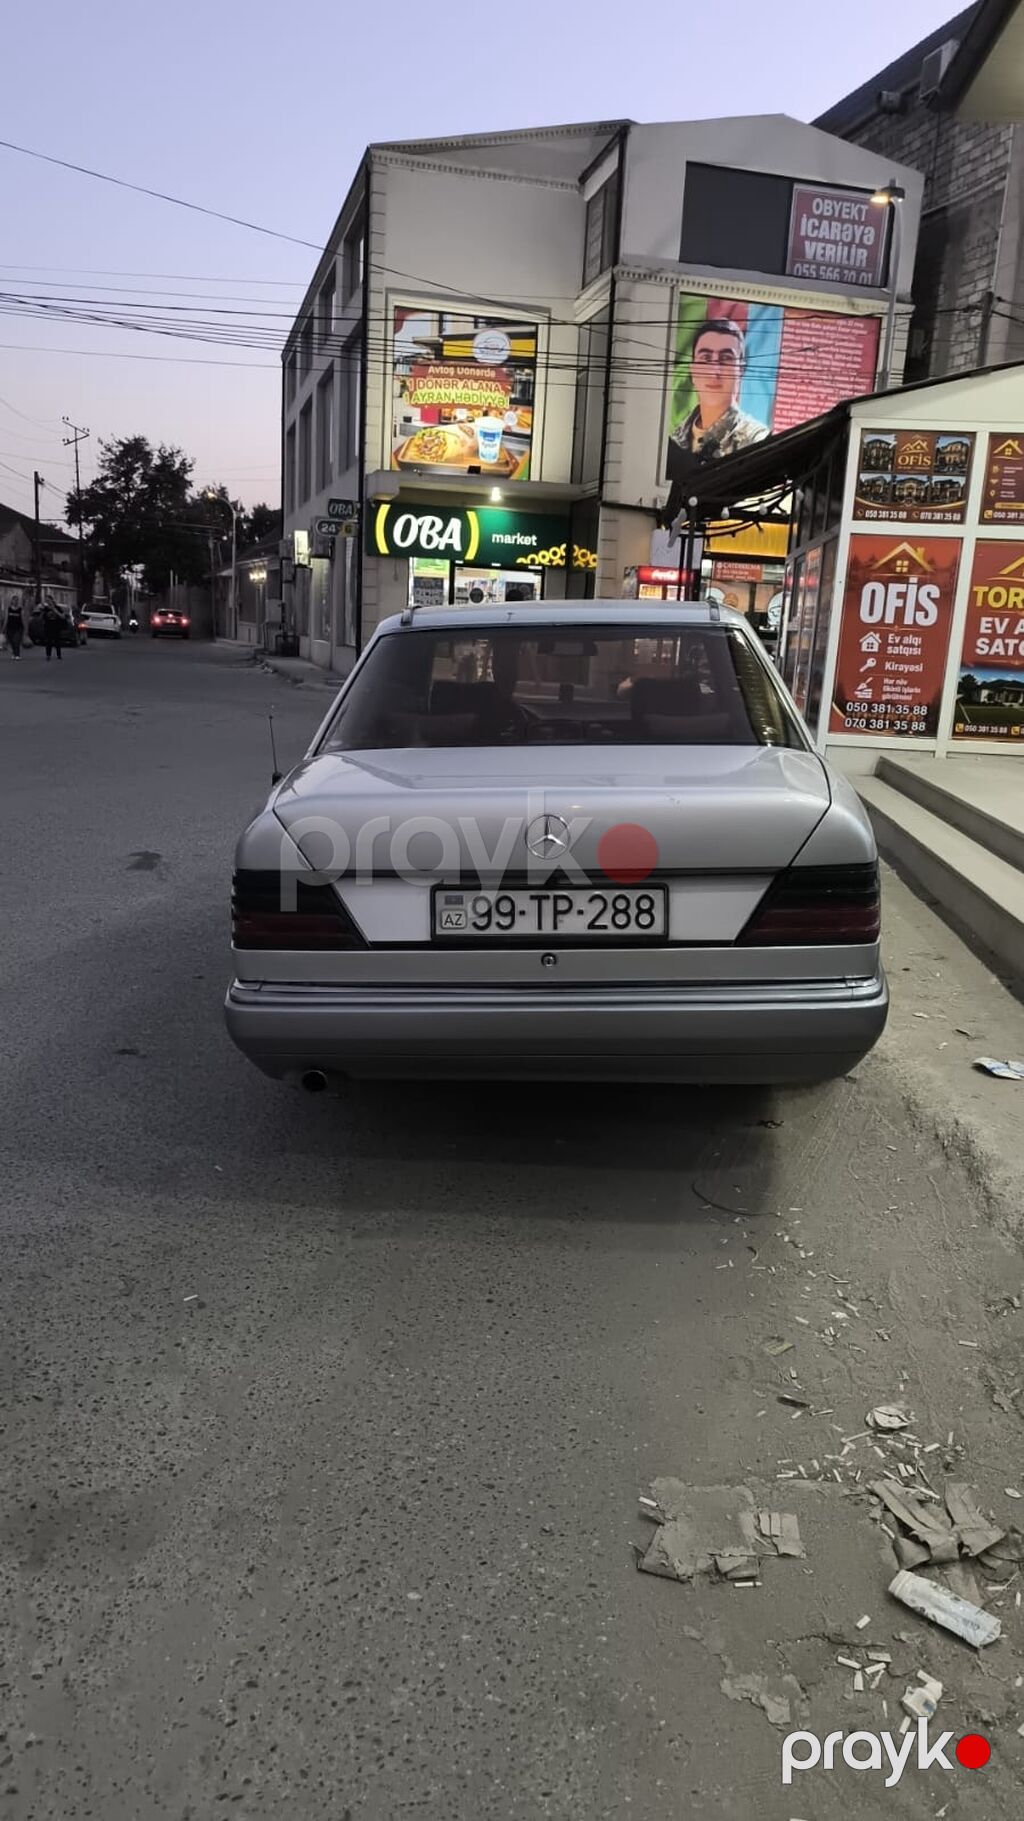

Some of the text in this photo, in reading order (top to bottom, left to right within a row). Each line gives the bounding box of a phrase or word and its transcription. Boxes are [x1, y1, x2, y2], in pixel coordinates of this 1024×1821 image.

[812, 197, 869, 222] OBYEKT
[800, 213, 875, 245] İCARƏYƏ
[804, 240, 868, 267] VERİLİR
[417, 376, 460, 391] DÖNƏR
[412, 391, 452, 404] AYRAN
[898, 454, 931, 466] OFİS
[865, 510, 877, 518] 050
[491, 532, 537, 547] market
[859, 576, 941, 627] OFİS
[973, 585, 1024, 609] TOR
[980, 616, 1010, 634] EV
[888, 633, 922, 647] Ev alqı
[887, 645, 921, 656] satqısı
[846, 702, 928, 716] 050 381 35 88
[844, 717, 926, 731] 070 381 35 88
[443, 894, 655, 931] AZ 99-TP-288
